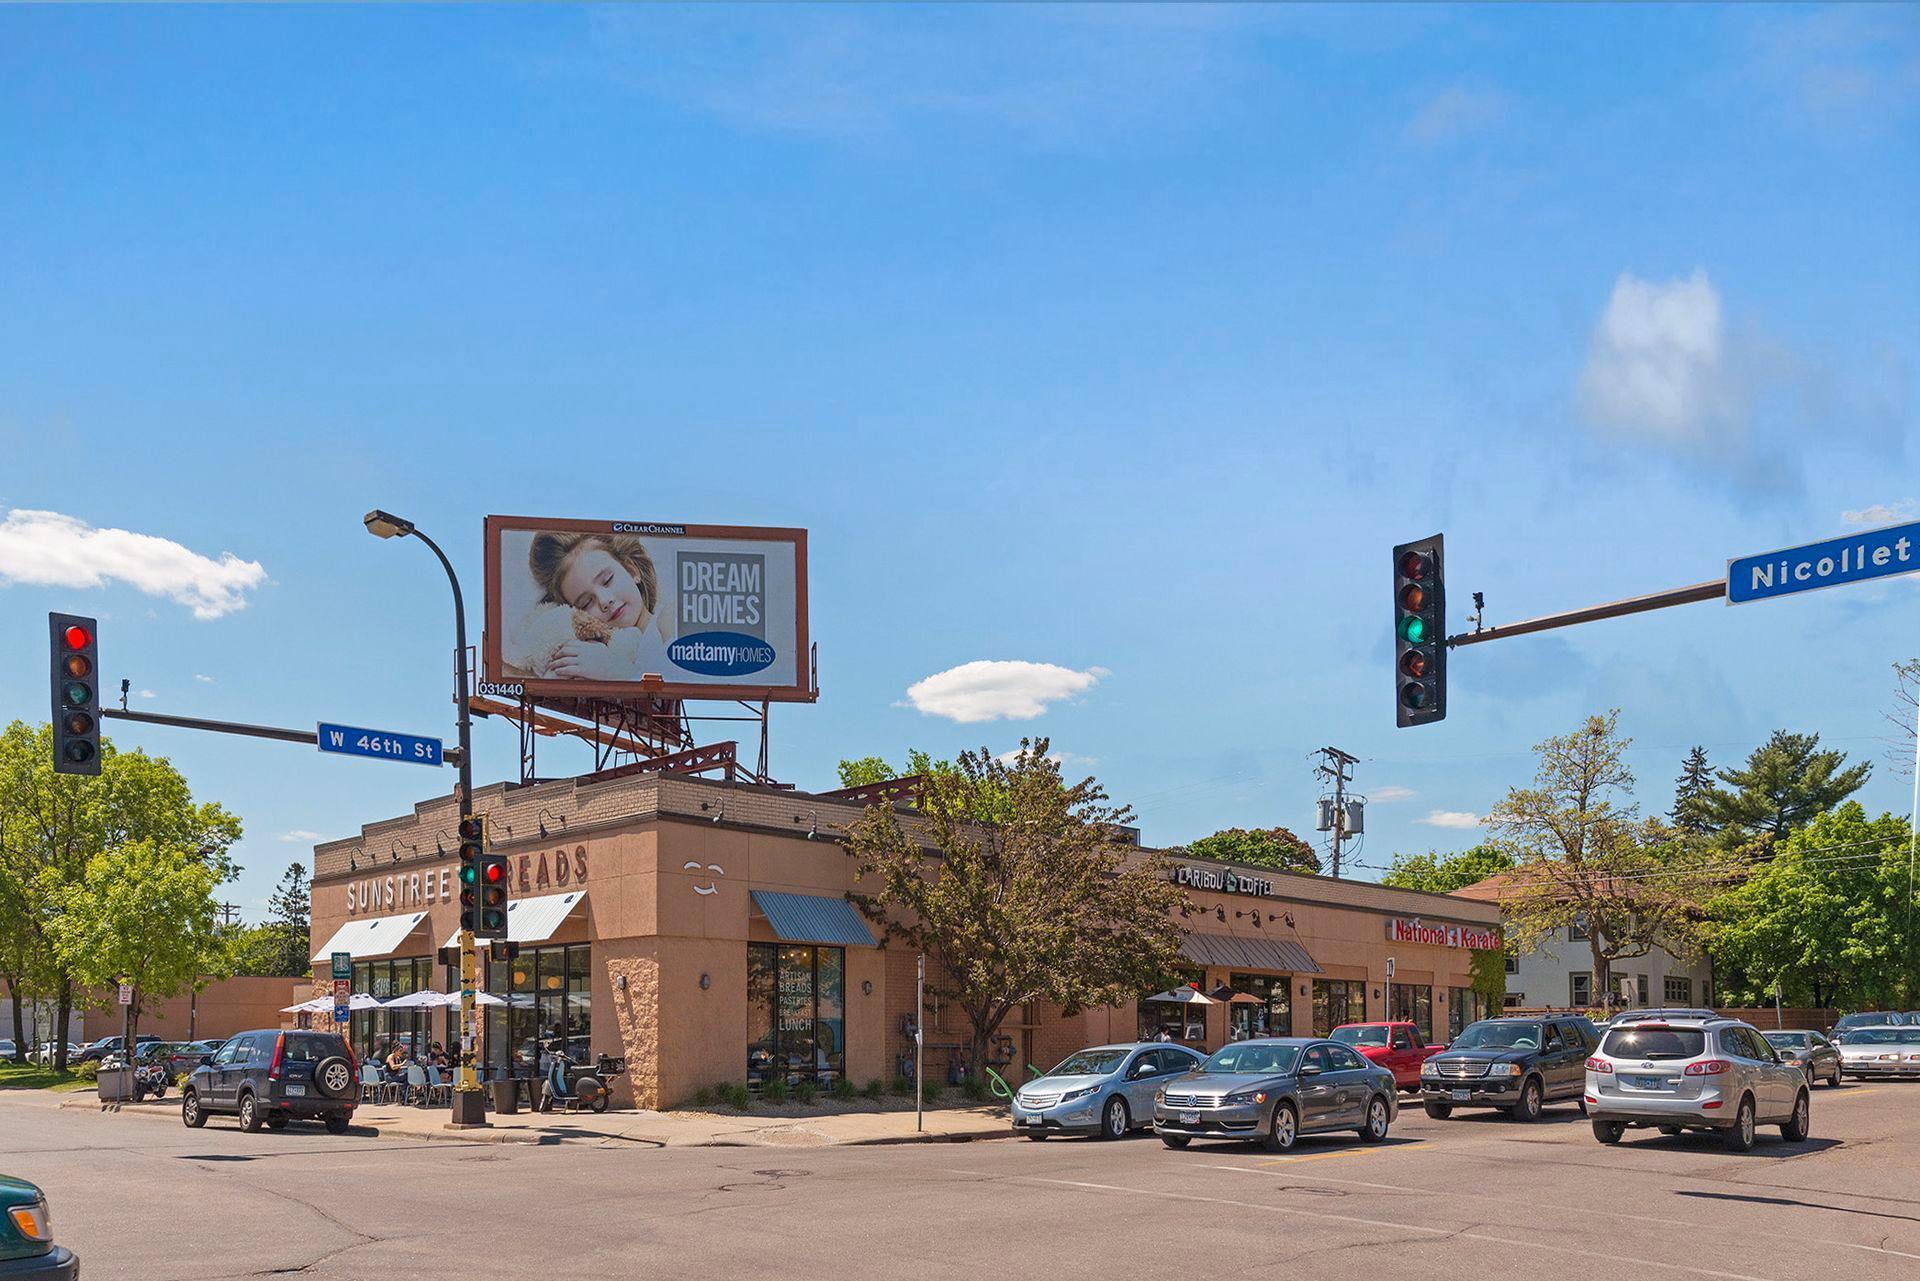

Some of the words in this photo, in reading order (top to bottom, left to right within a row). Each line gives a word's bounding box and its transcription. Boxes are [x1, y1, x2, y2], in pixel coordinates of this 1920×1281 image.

[1752, 536, 1911, 590] Nicollet
[682, 561, 760, 593] DREAM
[682, 594, 760, 625] HOMES
[479, 683, 523, 695] 031440
[330, 731, 344, 747] W
[356, 736, 403, 755] 46th
[414, 742, 433, 759] St
[347, 866, 461, 910] SUNSTREE
[1178, 867, 1224, 890] CARIBOU
[1396, 919, 1448, 946] National
[1460, 927, 1501, 950] Karate
[780, 982, 812, 993] BREADS
[779, 1008, 811, 1017] BREAST
[780, 996, 812, 1006] PASTRIES
[780, 1018, 812, 1031] LUNCH
